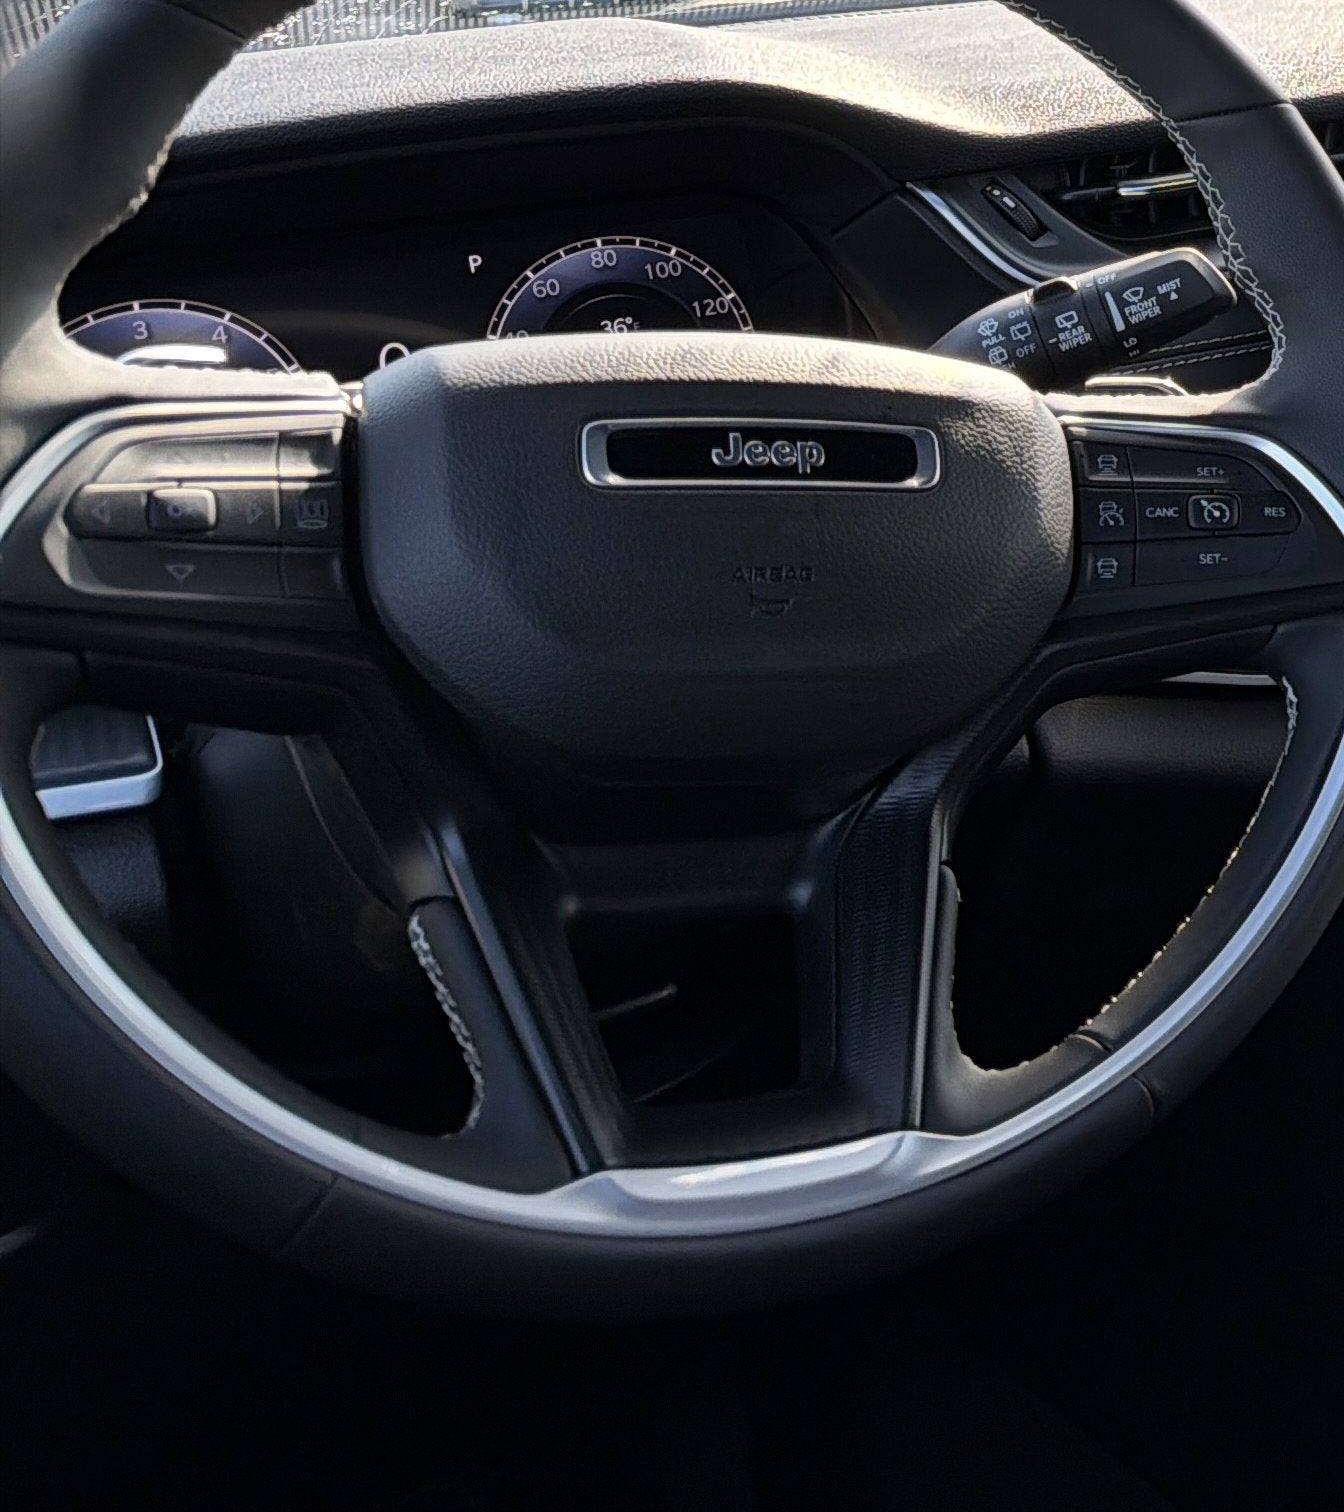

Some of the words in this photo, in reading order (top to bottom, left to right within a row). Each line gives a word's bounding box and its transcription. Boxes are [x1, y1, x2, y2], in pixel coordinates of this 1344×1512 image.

[467, 254, 483, 274] P
[590, 249, 617, 269] 80
[644, 259, 682, 281] 100
[1096, 272, 1118, 286] OFF
[532, 278, 560, 299] 60
[1156, 277, 1183, 296] MIST
[691, 294, 729, 318] 120
[1007, 307, 1026, 320] ON
[1123, 296, 1159, 317] FRONT
[1127, 304, 1163, 326] WIPER
[132, 320, 149, 340] 3
[211, 325, 229, 344] 4
[981, 332, 1007, 348] PULL
[1058, 324, 1086, 343] REAR
[1015, 342, 1037, 359] OFF
[1058, 332, 1093, 352] WIPER
[1121, 336, 1139, 349] LO
[711, 432, 826, 474] Jeep
[1145, 507, 1180, 518] CANC
[1264, 506, 1287, 518] RES
[731, 564, 816, 585] AIRBAG
